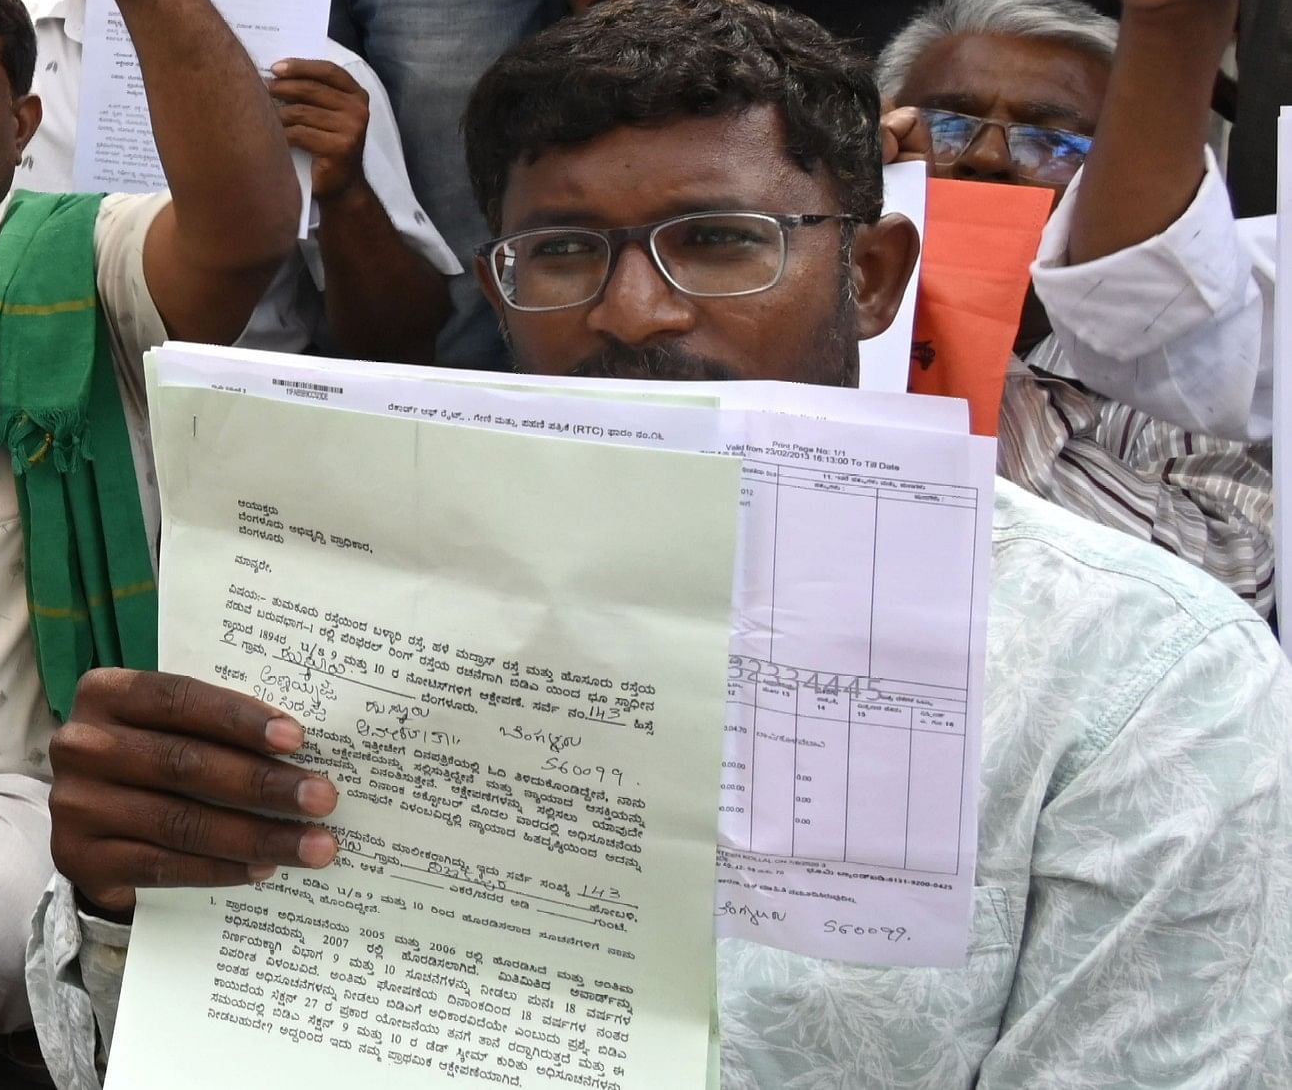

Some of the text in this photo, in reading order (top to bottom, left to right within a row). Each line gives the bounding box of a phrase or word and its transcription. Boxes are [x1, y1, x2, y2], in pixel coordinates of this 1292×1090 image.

[572, 424, 604, 438] (RTC)
[726, 443, 745, 452] Valid
[746, 444, 764, 453] from
[851, 458, 862, 467] To
[879, 462, 900, 471] Date
[793, 443, 814, 455] Page
[834, 449, 846, 457] 1/1
[237, 499, 279, 517] ಆಯುಕ್ತರು
[238, 512, 284, 530] ಬೆಂಗಳೂರು
[238, 525, 284, 544] ಬೆಂಗಳೂರು
